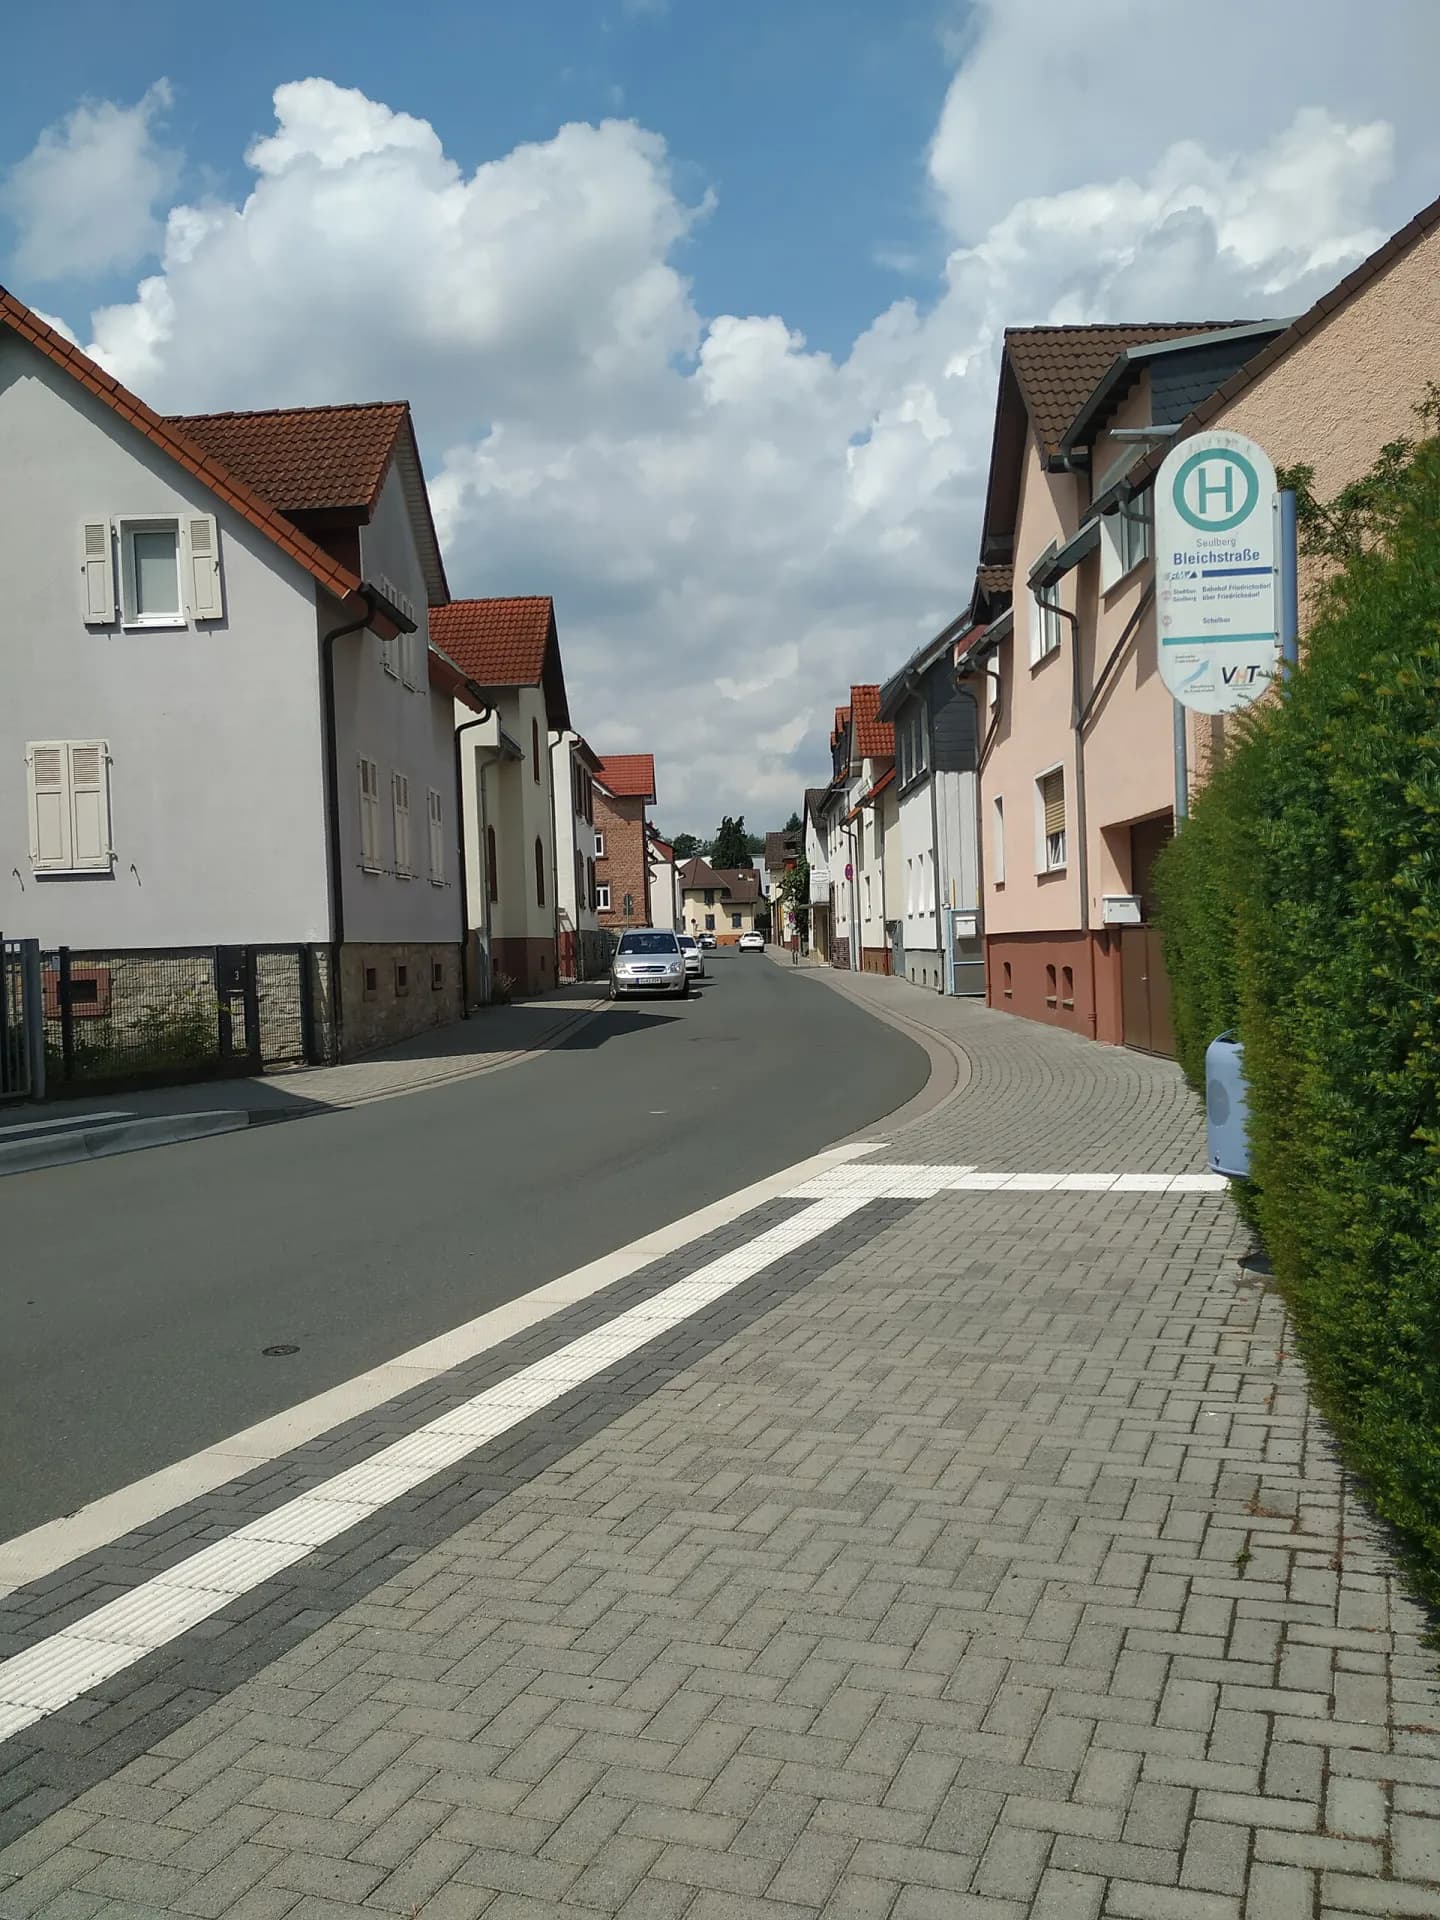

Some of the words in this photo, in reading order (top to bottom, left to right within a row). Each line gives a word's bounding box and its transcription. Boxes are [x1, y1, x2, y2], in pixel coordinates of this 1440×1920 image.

[1198, 466, 1234, 514] H
[1196, 538, 1237, 548] Seulberg
[1173, 549, 1260, 565] Bleichstraße
